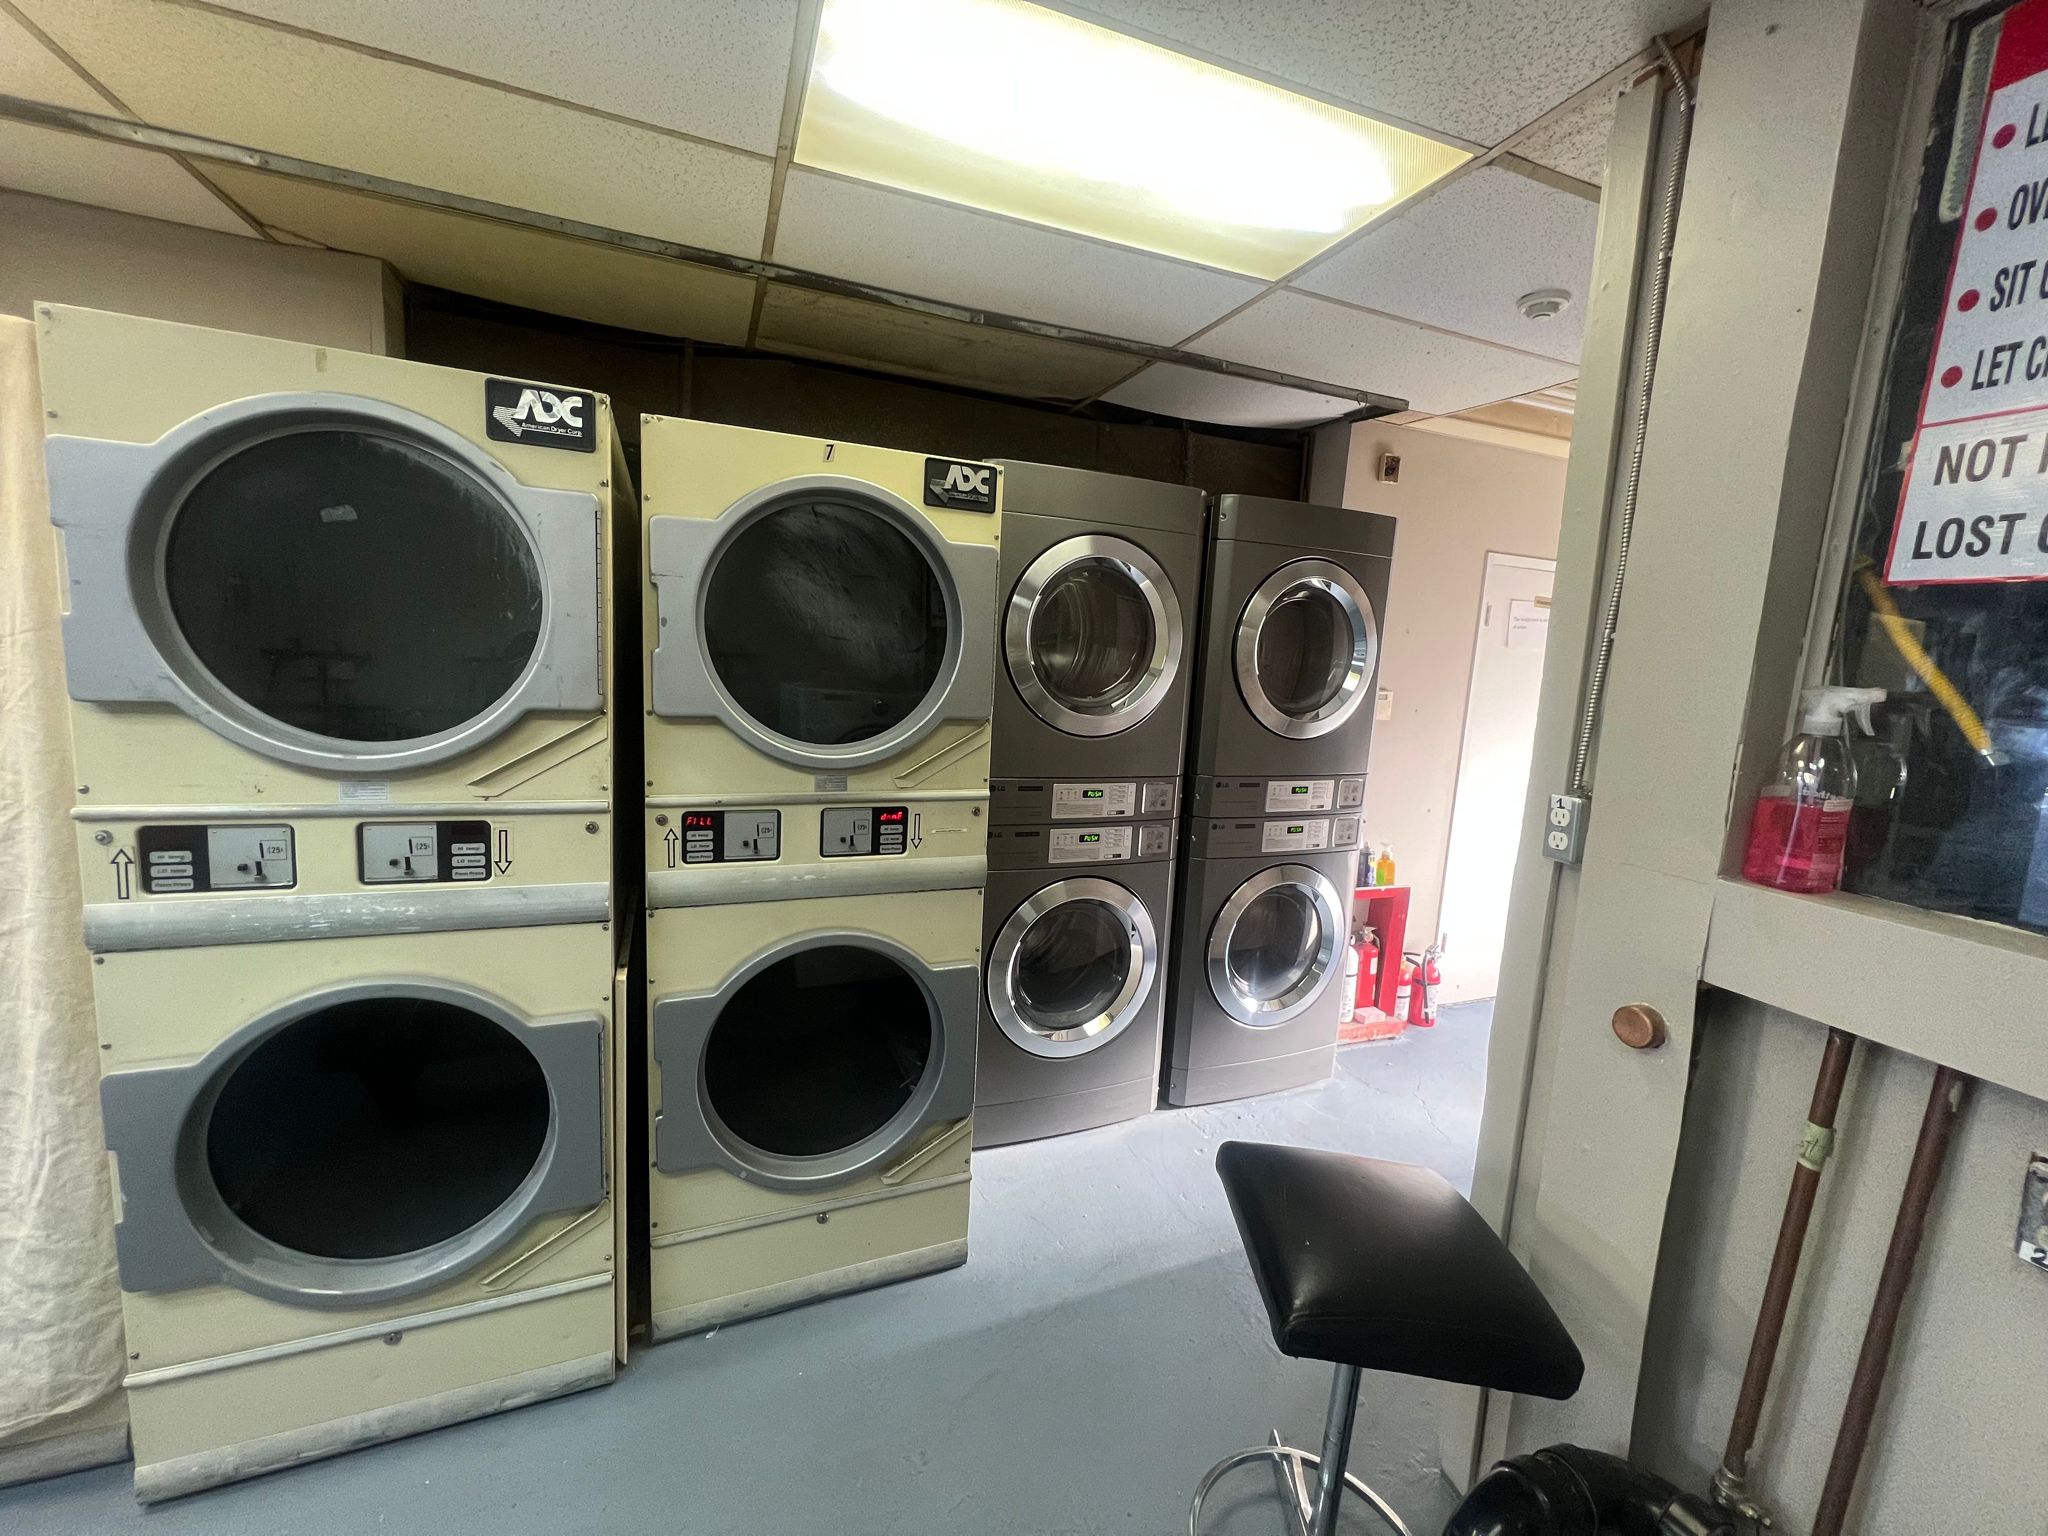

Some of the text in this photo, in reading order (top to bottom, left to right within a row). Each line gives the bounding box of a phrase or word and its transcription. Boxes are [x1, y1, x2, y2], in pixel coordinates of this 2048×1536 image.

[2008, 178, 2048, 231] OV
[1990, 259, 2038, 312] SIT
[1971, 335, 2048, 391] LET C
[511, 388, 583, 428] ADC
[826, 444, 834, 461] 7
[1933, 434, 2028, 486] NOT
[943, 464, 990, 495] ADC
[1911, 512, 2027, 560] LOST
[686, 816, 712, 826] FILL
[1556, 798, 1565, 809] 1
